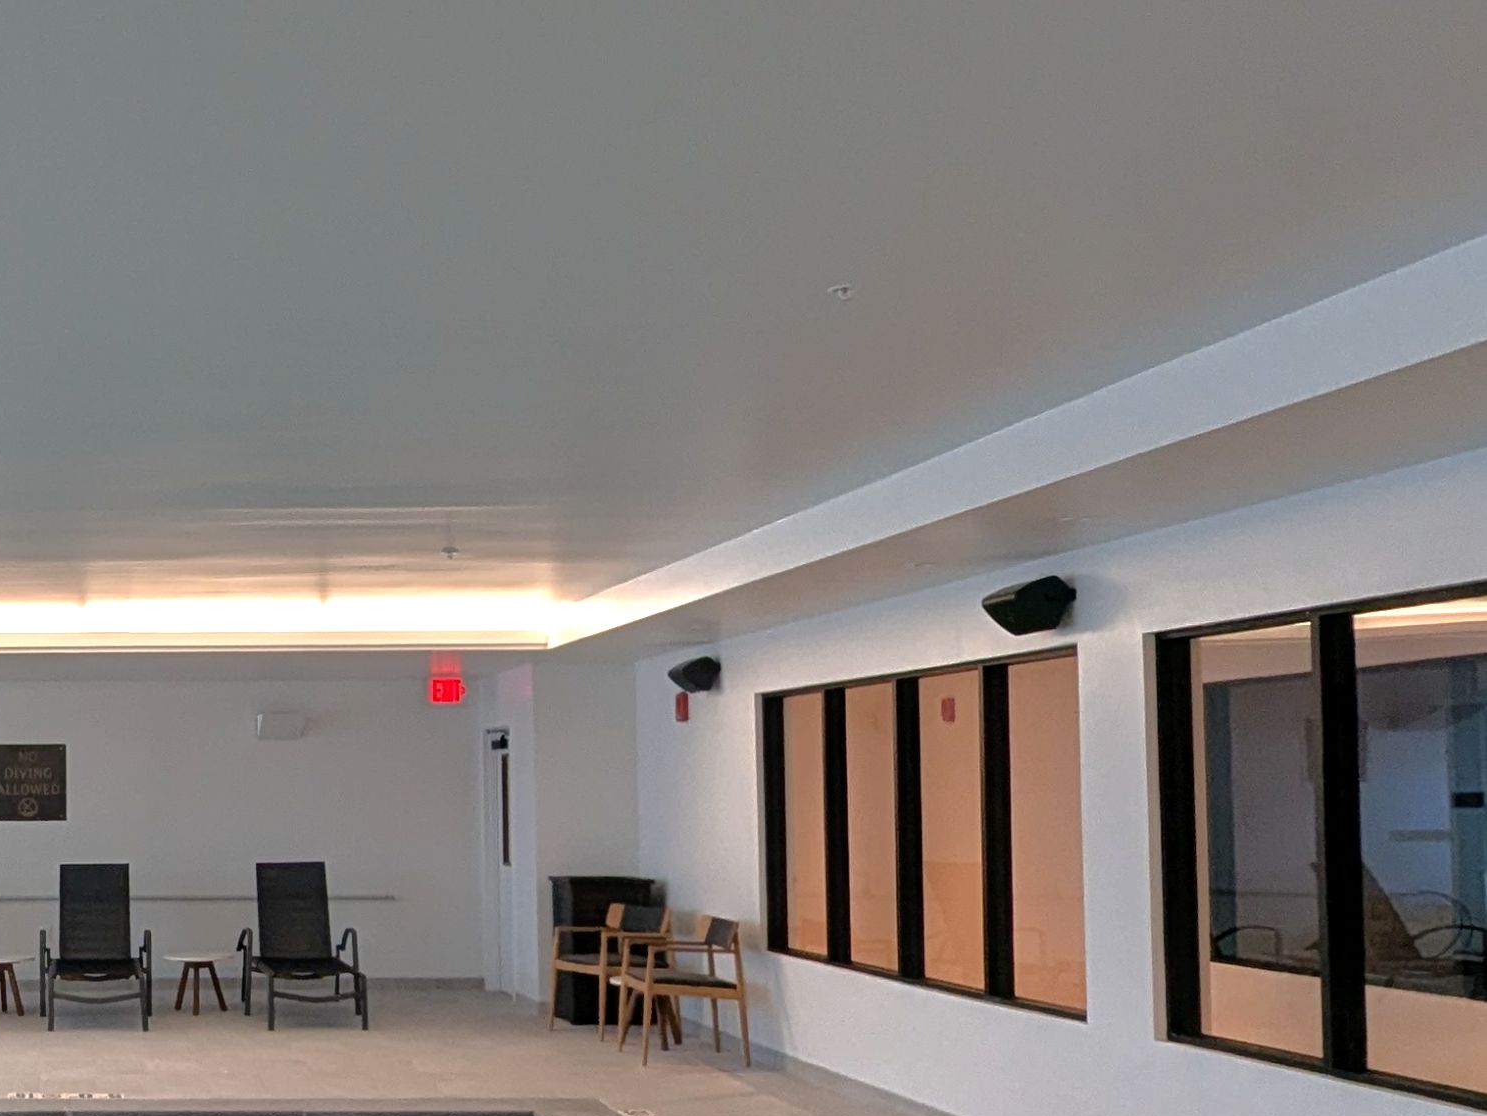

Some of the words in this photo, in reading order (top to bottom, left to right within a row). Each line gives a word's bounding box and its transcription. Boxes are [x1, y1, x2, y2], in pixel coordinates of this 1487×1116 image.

[433, 680, 461, 702] EXIT
[18, 751, 37, 761] NO
[4, 768, 52, 779] DIVING
